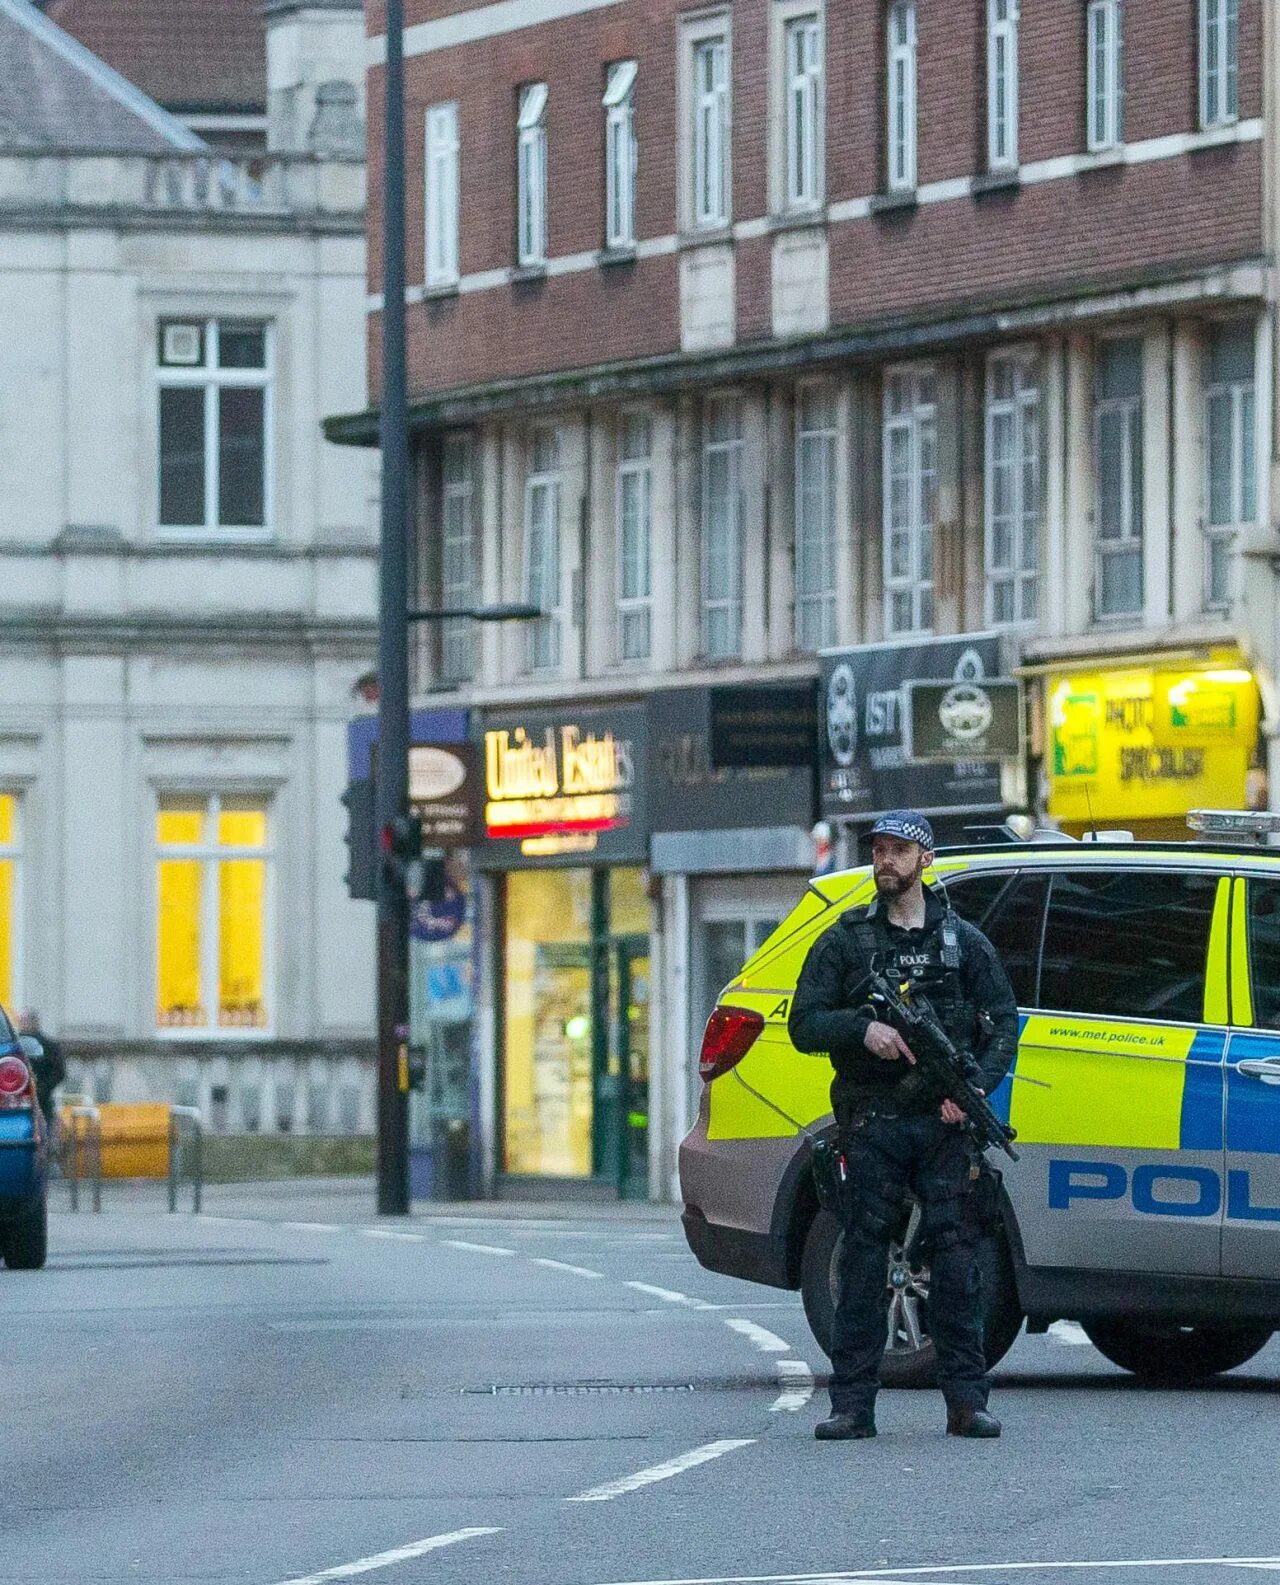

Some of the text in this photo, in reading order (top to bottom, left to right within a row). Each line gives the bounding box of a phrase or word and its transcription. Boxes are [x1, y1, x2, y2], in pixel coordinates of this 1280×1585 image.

[484, 725, 558, 800] United
[562, 725, 635, 795] Estates
[899, 953, 930, 965] POLICE
[1049, 1026, 1166, 1046] www.met.police.uk
